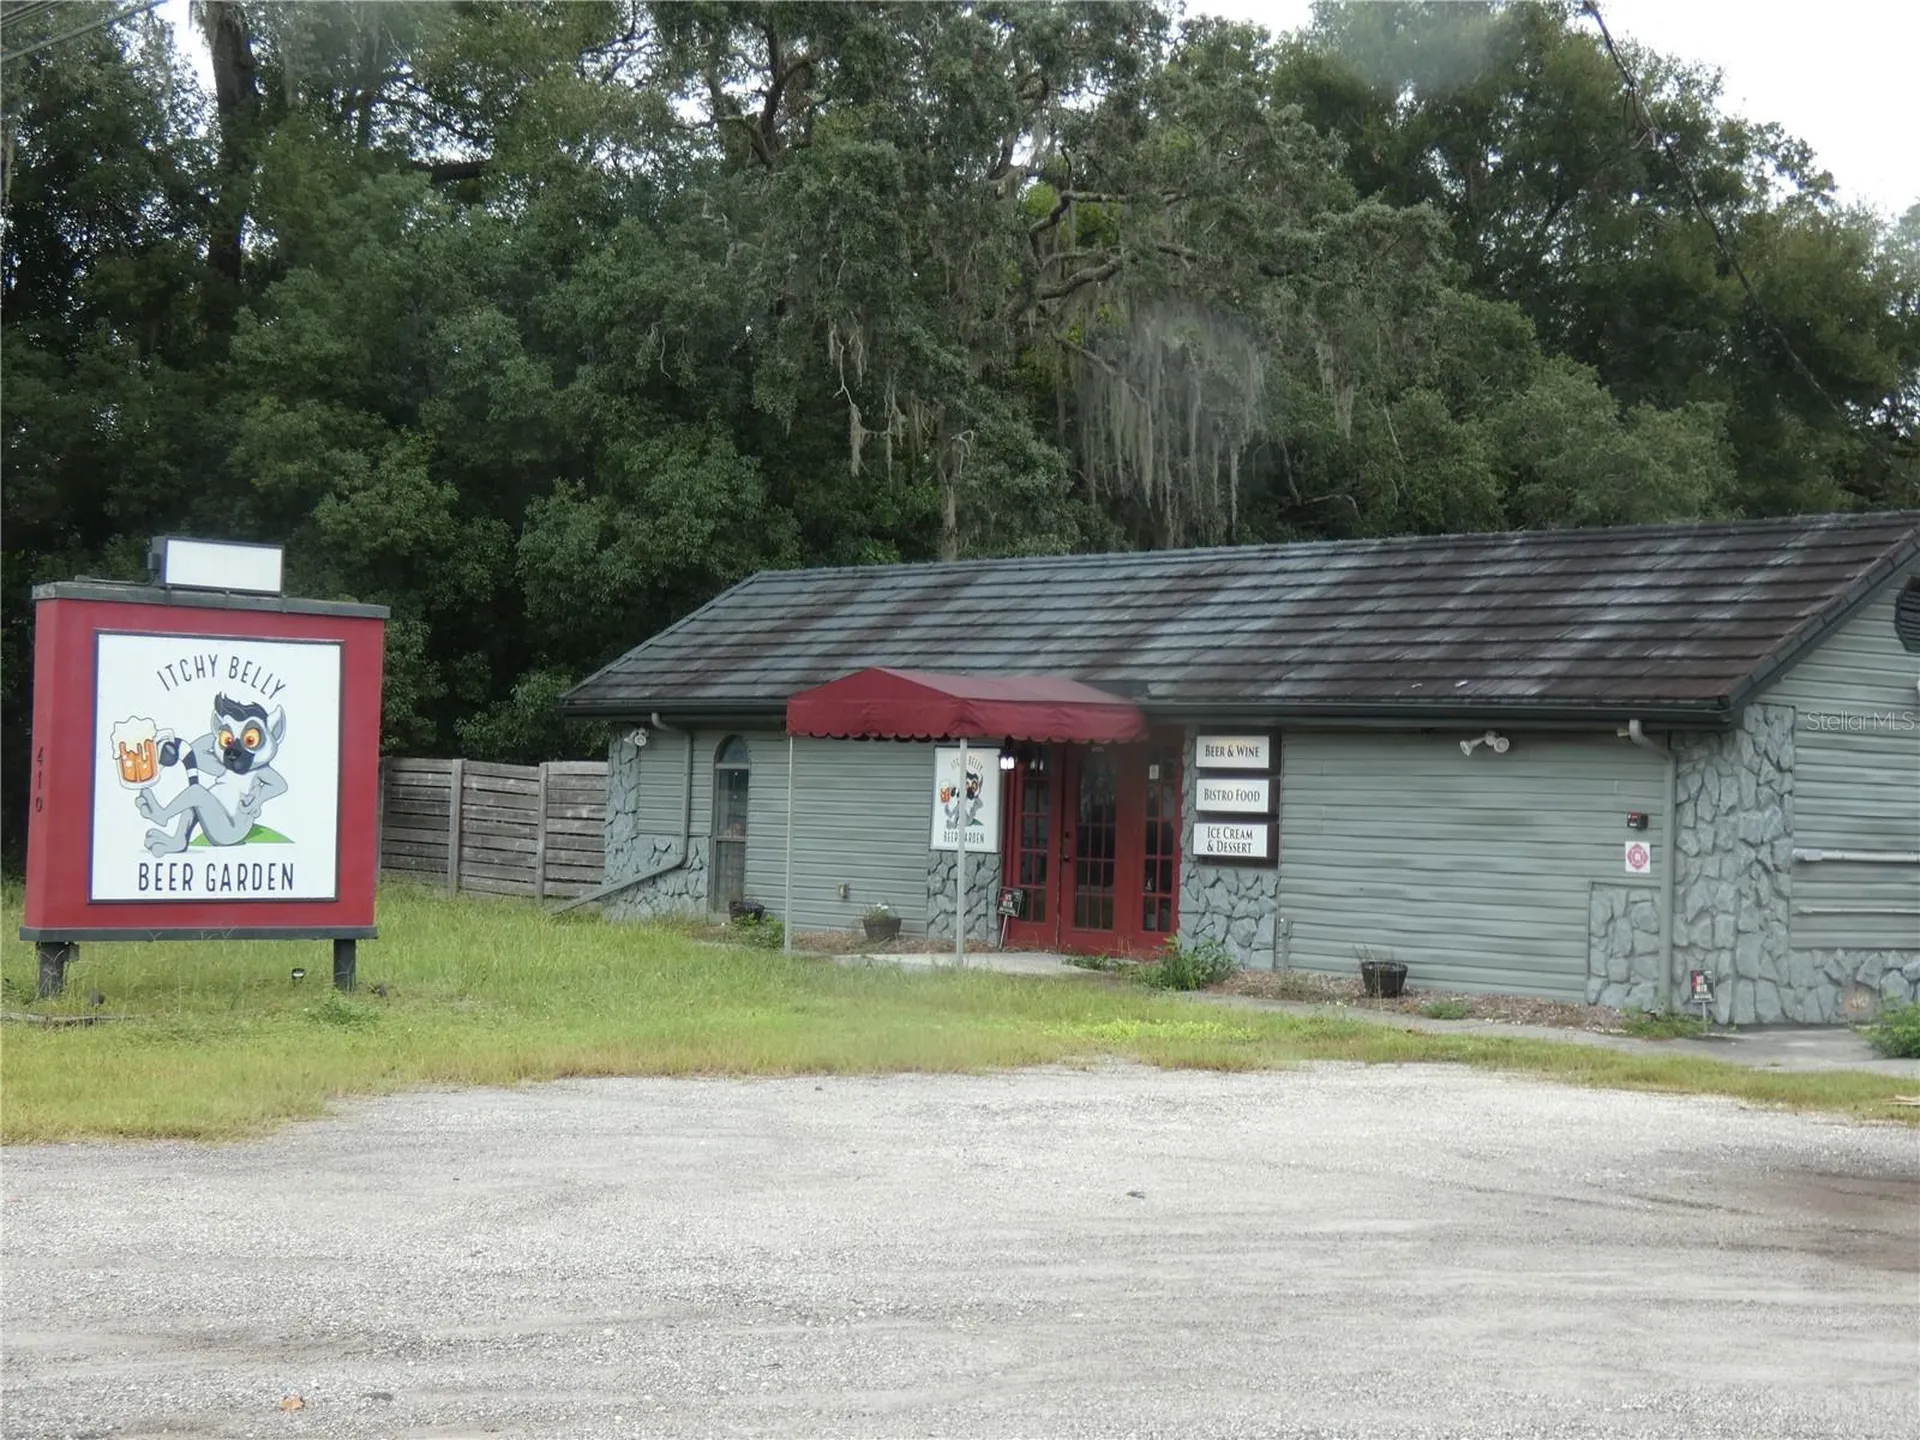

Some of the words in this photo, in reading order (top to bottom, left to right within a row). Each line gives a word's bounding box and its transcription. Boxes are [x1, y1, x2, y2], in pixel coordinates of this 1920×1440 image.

[157, 654, 218, 691] ITCHY
[228, 655, 286, 700] BELLY
[1205, 745, 1225, 757] BEER
[1227, 745, 1234, 758] &
[1236, 745, 1260, 758] WINE
[1204, 788, 1234, 801] BISTRO
[1236, 789, 1260, 802] FOOD
[1207, 826, 1221, 839] ICE
[1223, 827, 1253, 840] CREAM
[1206, 840, 1214, 853] &
[1216, 841, 1252, 854] DESSERT
[138, 862, 194, 891] BEER
[206, 863, 294, 892] GARDEN
